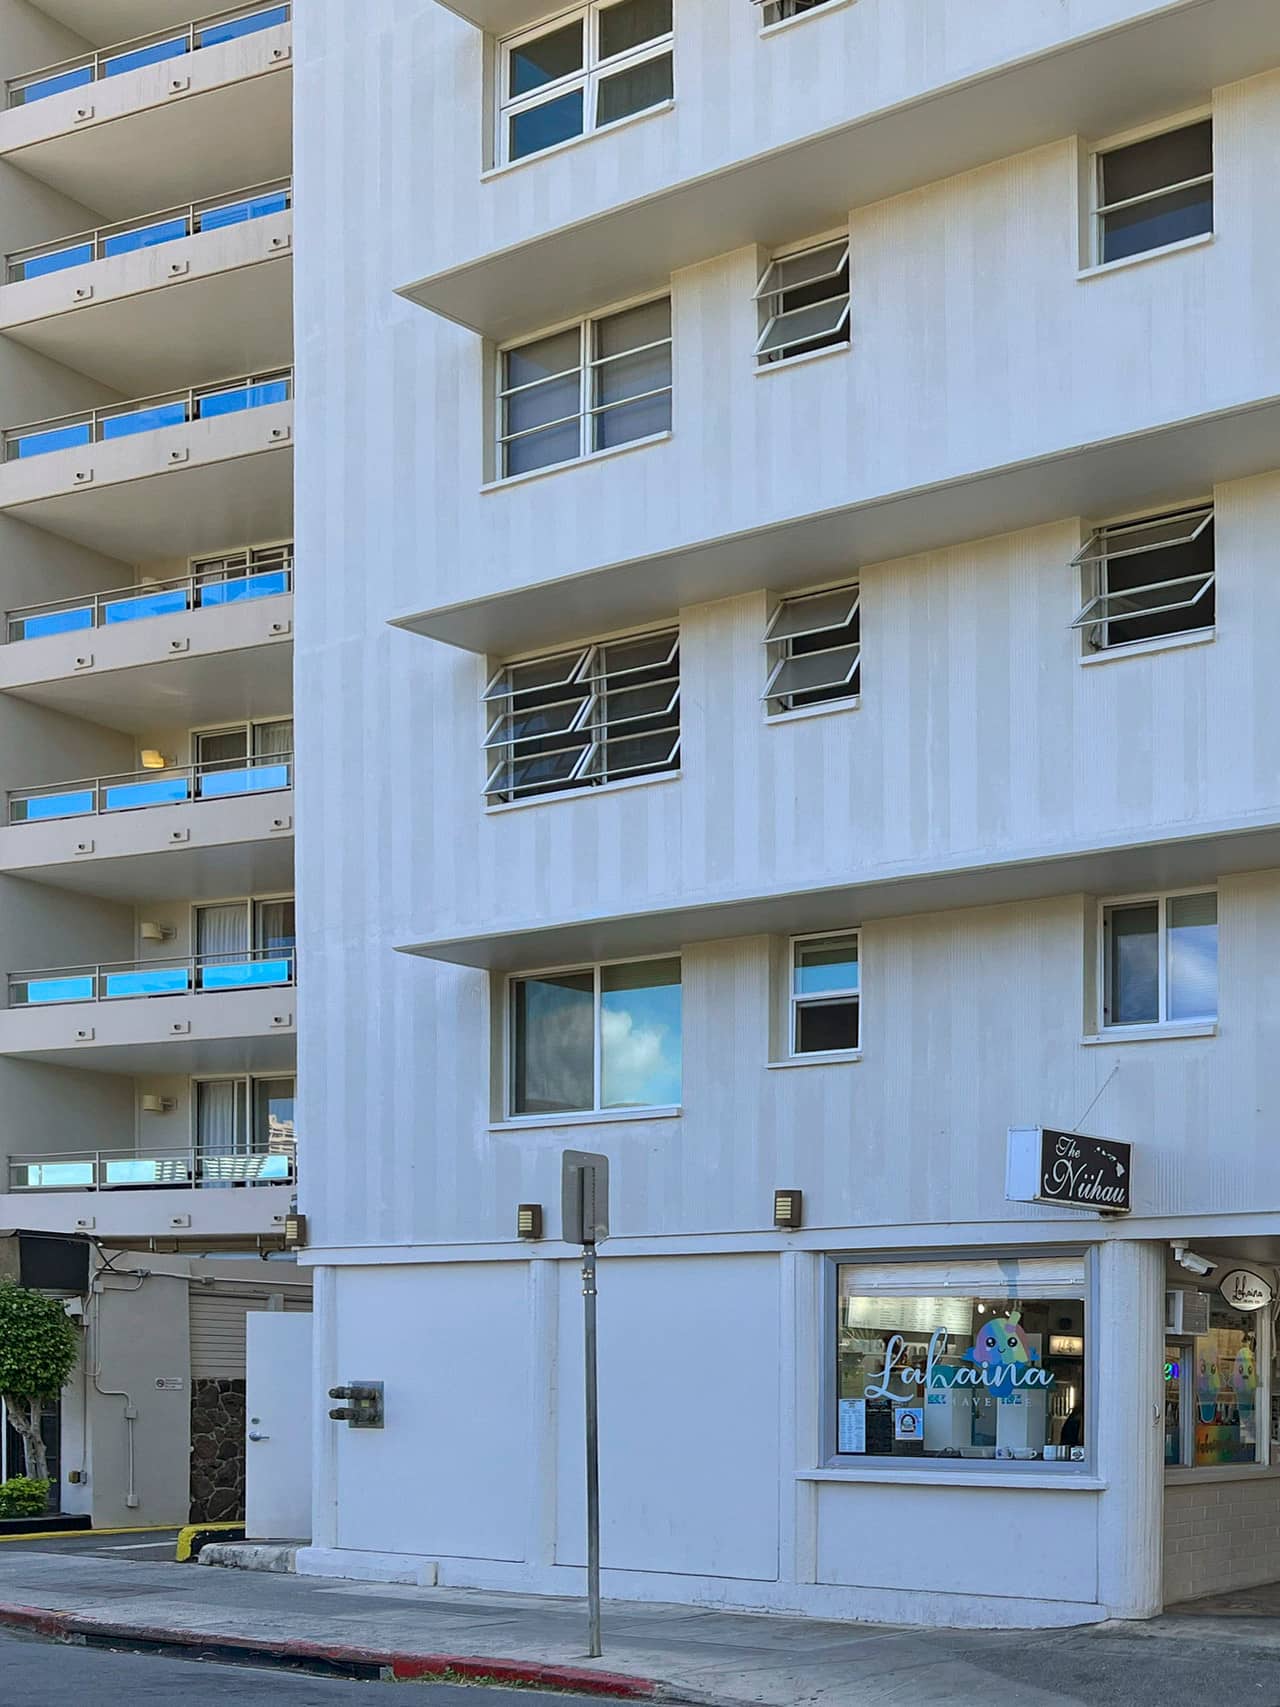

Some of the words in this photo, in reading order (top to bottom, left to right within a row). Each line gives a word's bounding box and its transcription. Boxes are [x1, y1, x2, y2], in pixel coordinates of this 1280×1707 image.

[1055, 1136, 1081, 1158] The
[1043, 1159, 1126, 1203] Niihau
[864, 1326, 1055, 1403] Lahaina
